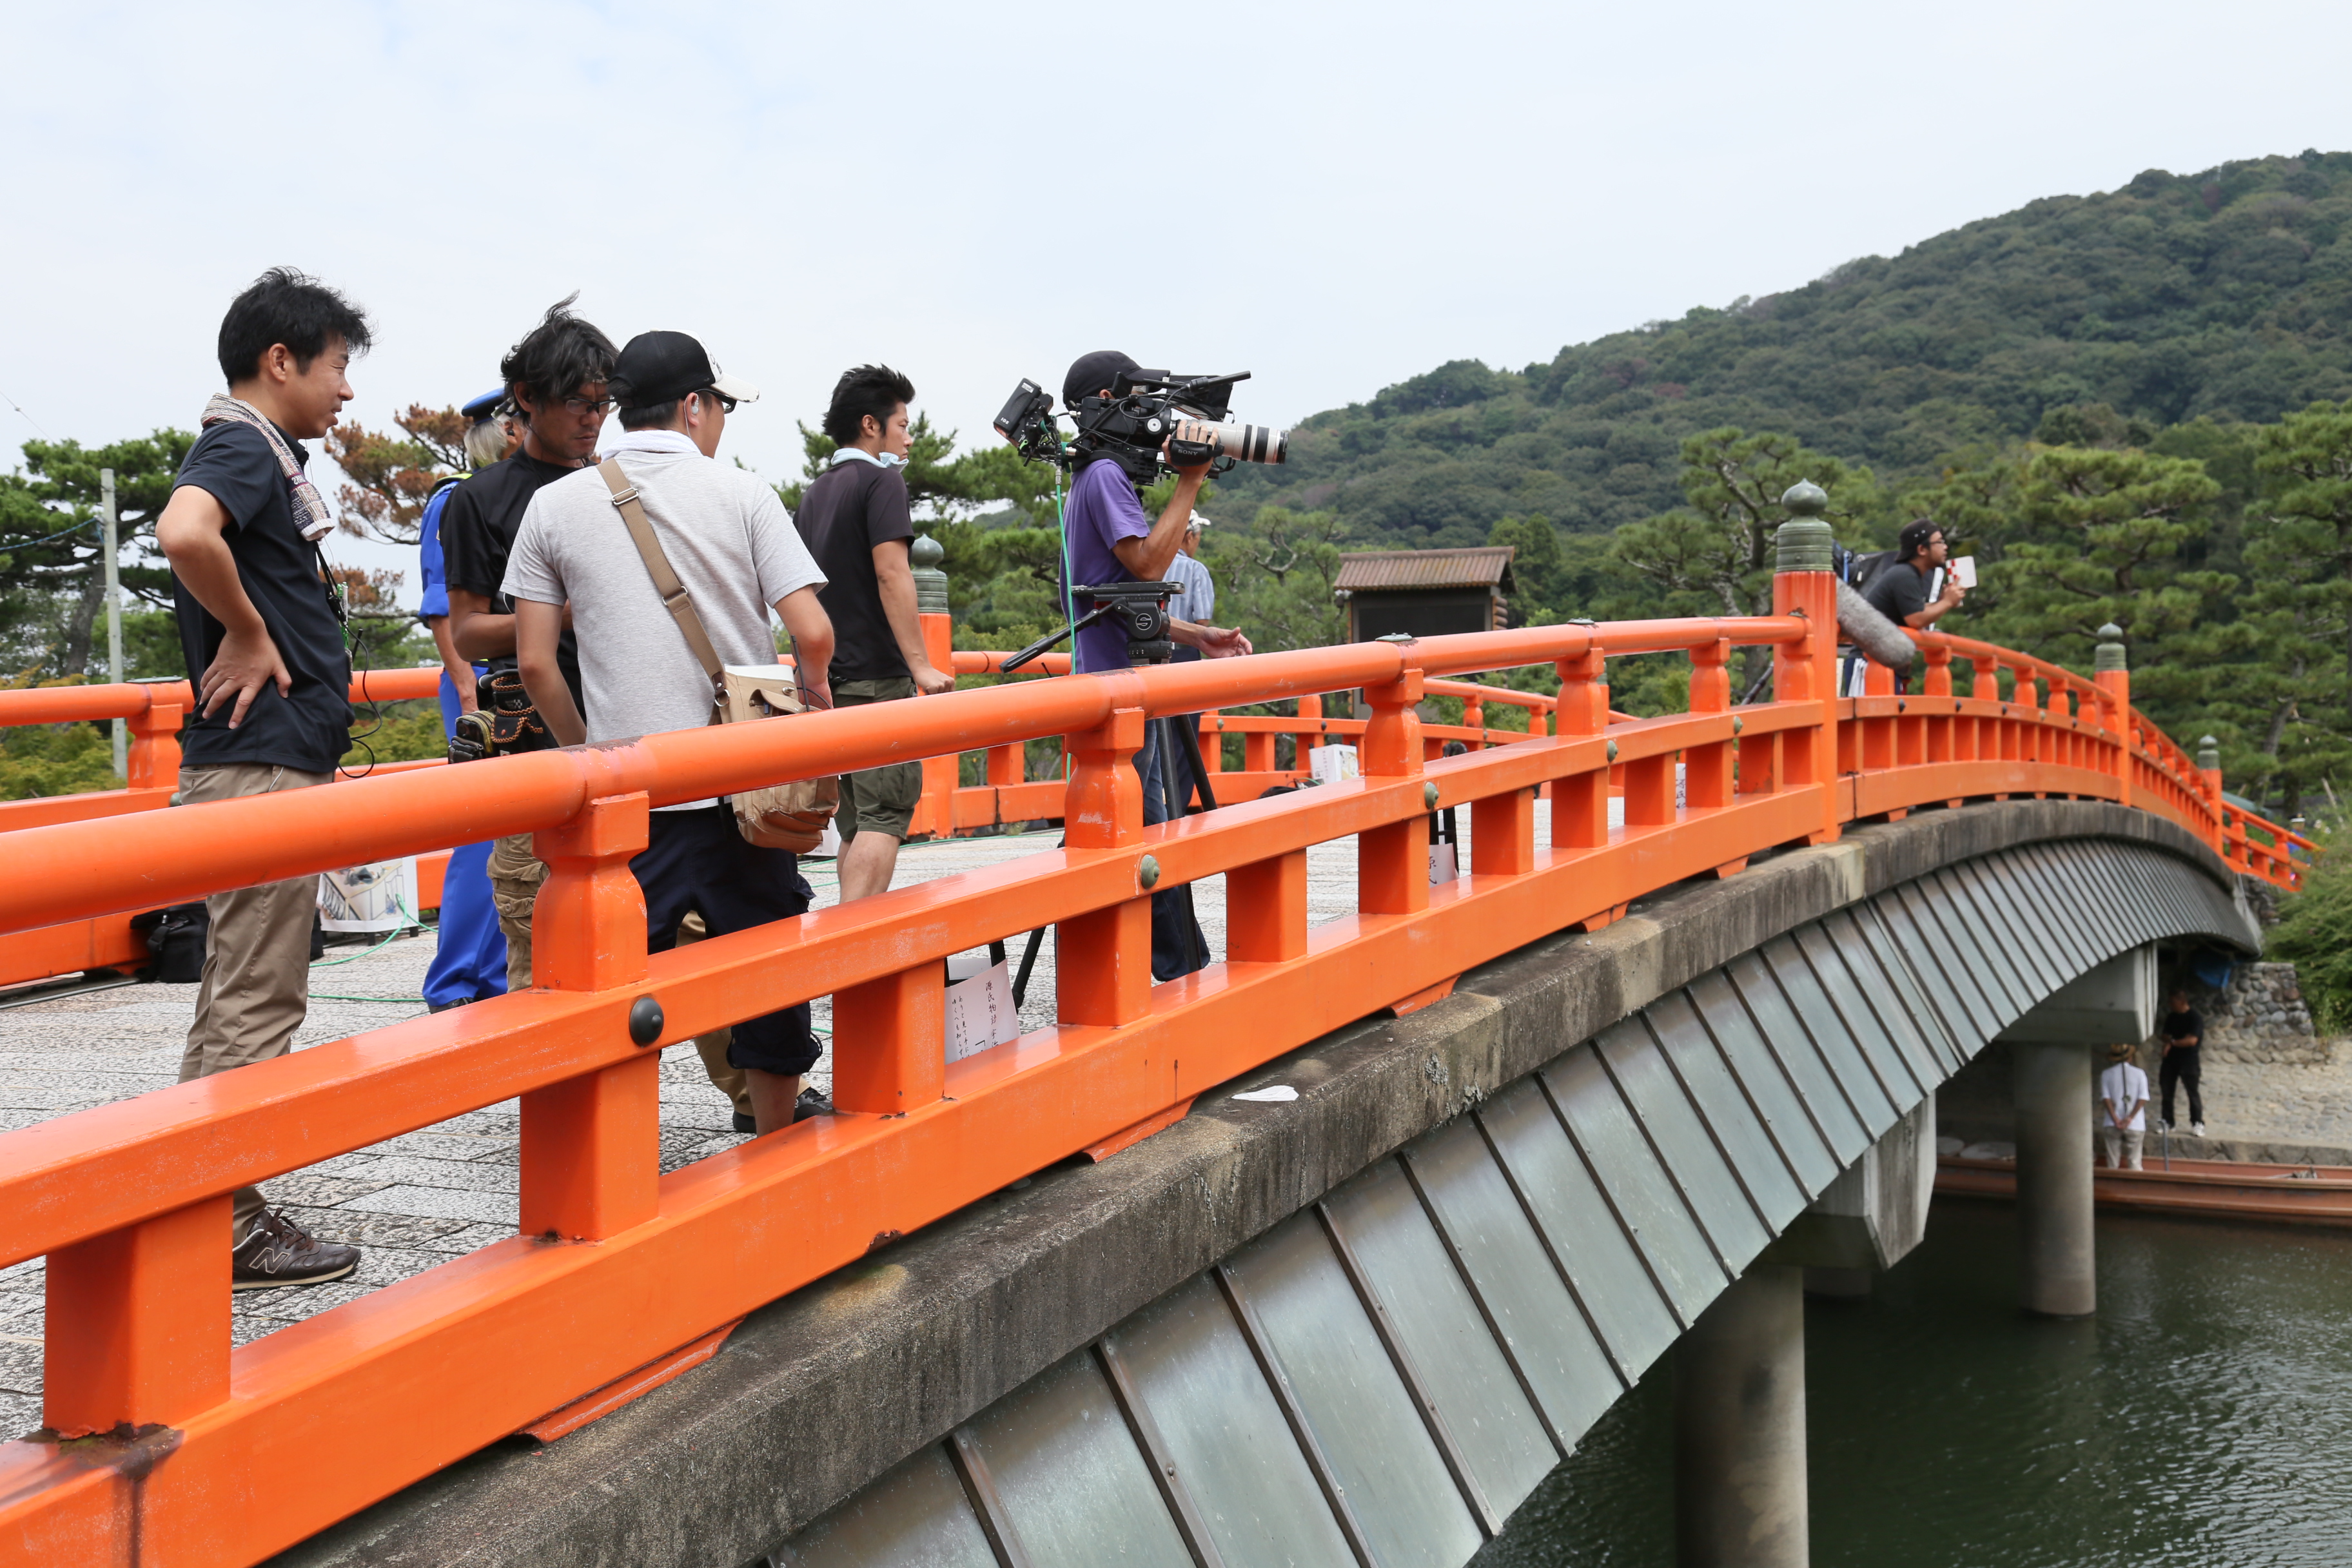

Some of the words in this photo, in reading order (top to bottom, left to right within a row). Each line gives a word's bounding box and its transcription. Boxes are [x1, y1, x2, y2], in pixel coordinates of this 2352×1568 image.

[959, 995, 970, 1057] ありと見て手に
[985, 980, 997, 1025] 源氏物語
[952, 999, 964, 1060] ゆくへも知らず
[248, 1246, 291, 1274] N
